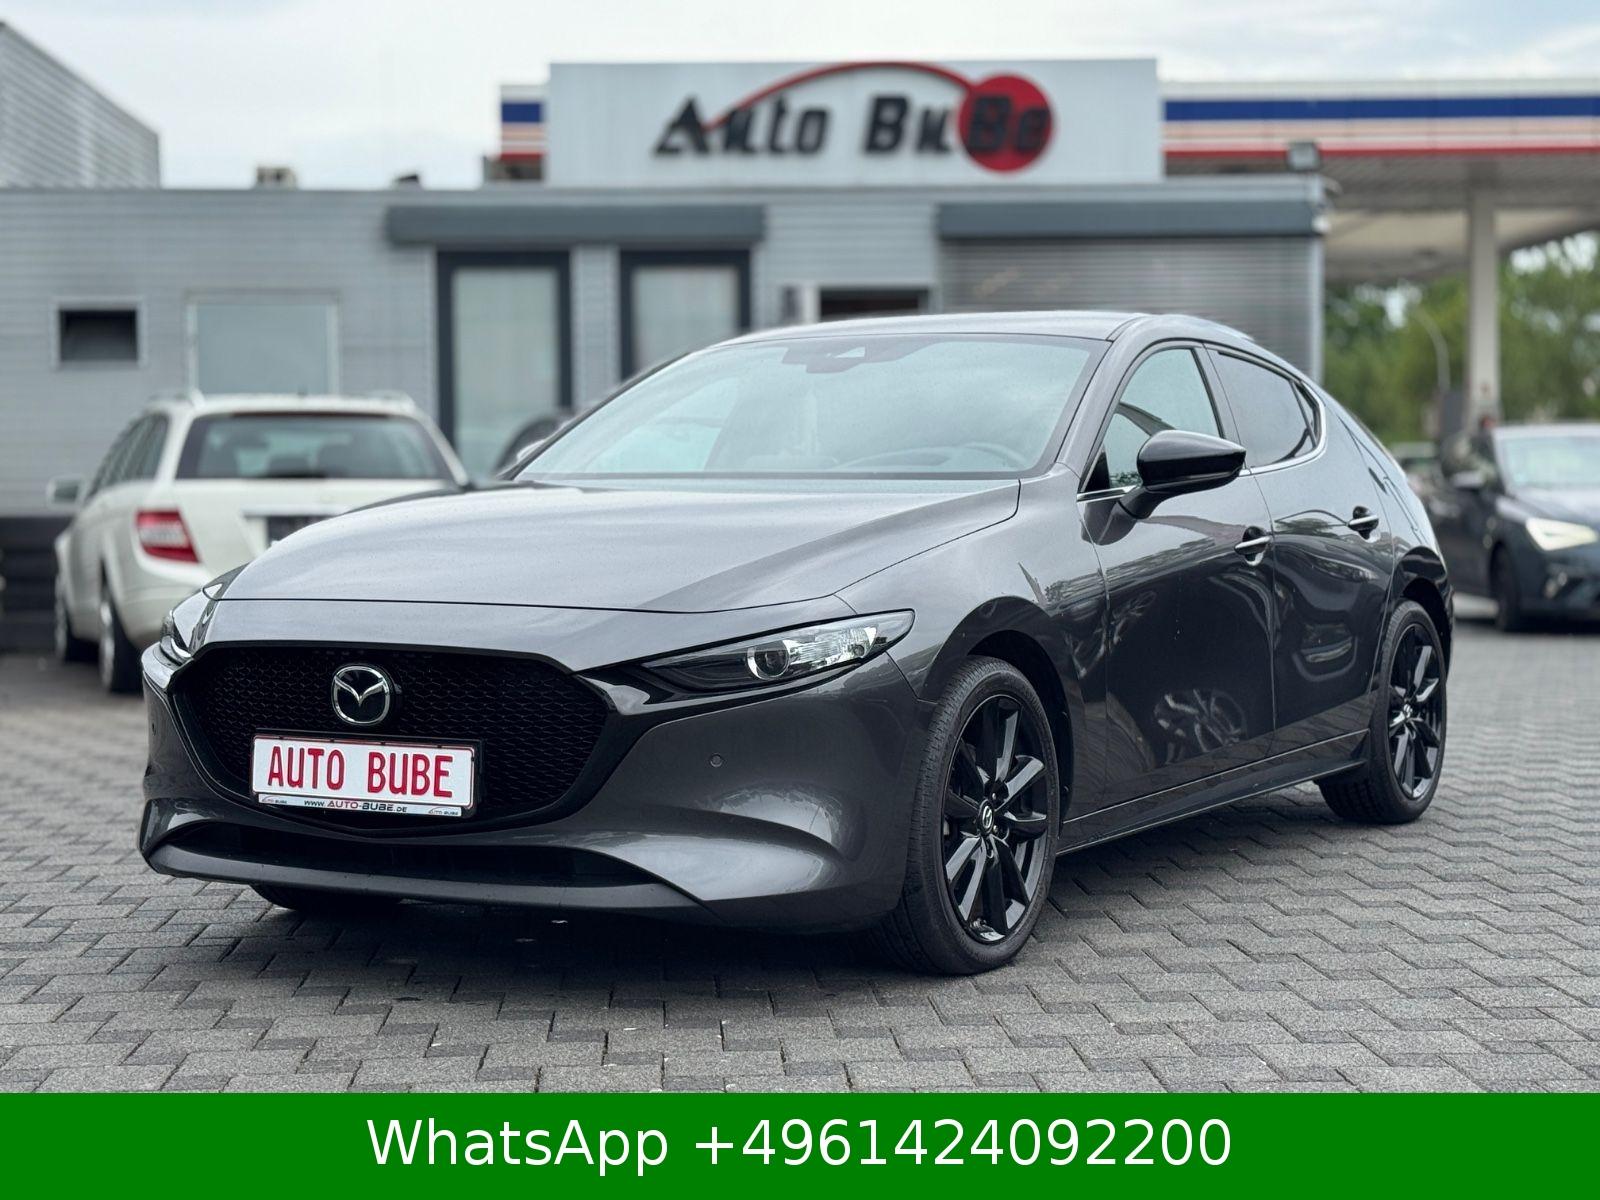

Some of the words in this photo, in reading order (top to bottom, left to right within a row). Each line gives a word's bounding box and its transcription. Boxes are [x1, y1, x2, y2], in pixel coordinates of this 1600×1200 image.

[653, 94, 829, 155] Auto
[267, 746, 345, 790] AUTO
[367, 751, 453, 798] BUBE
